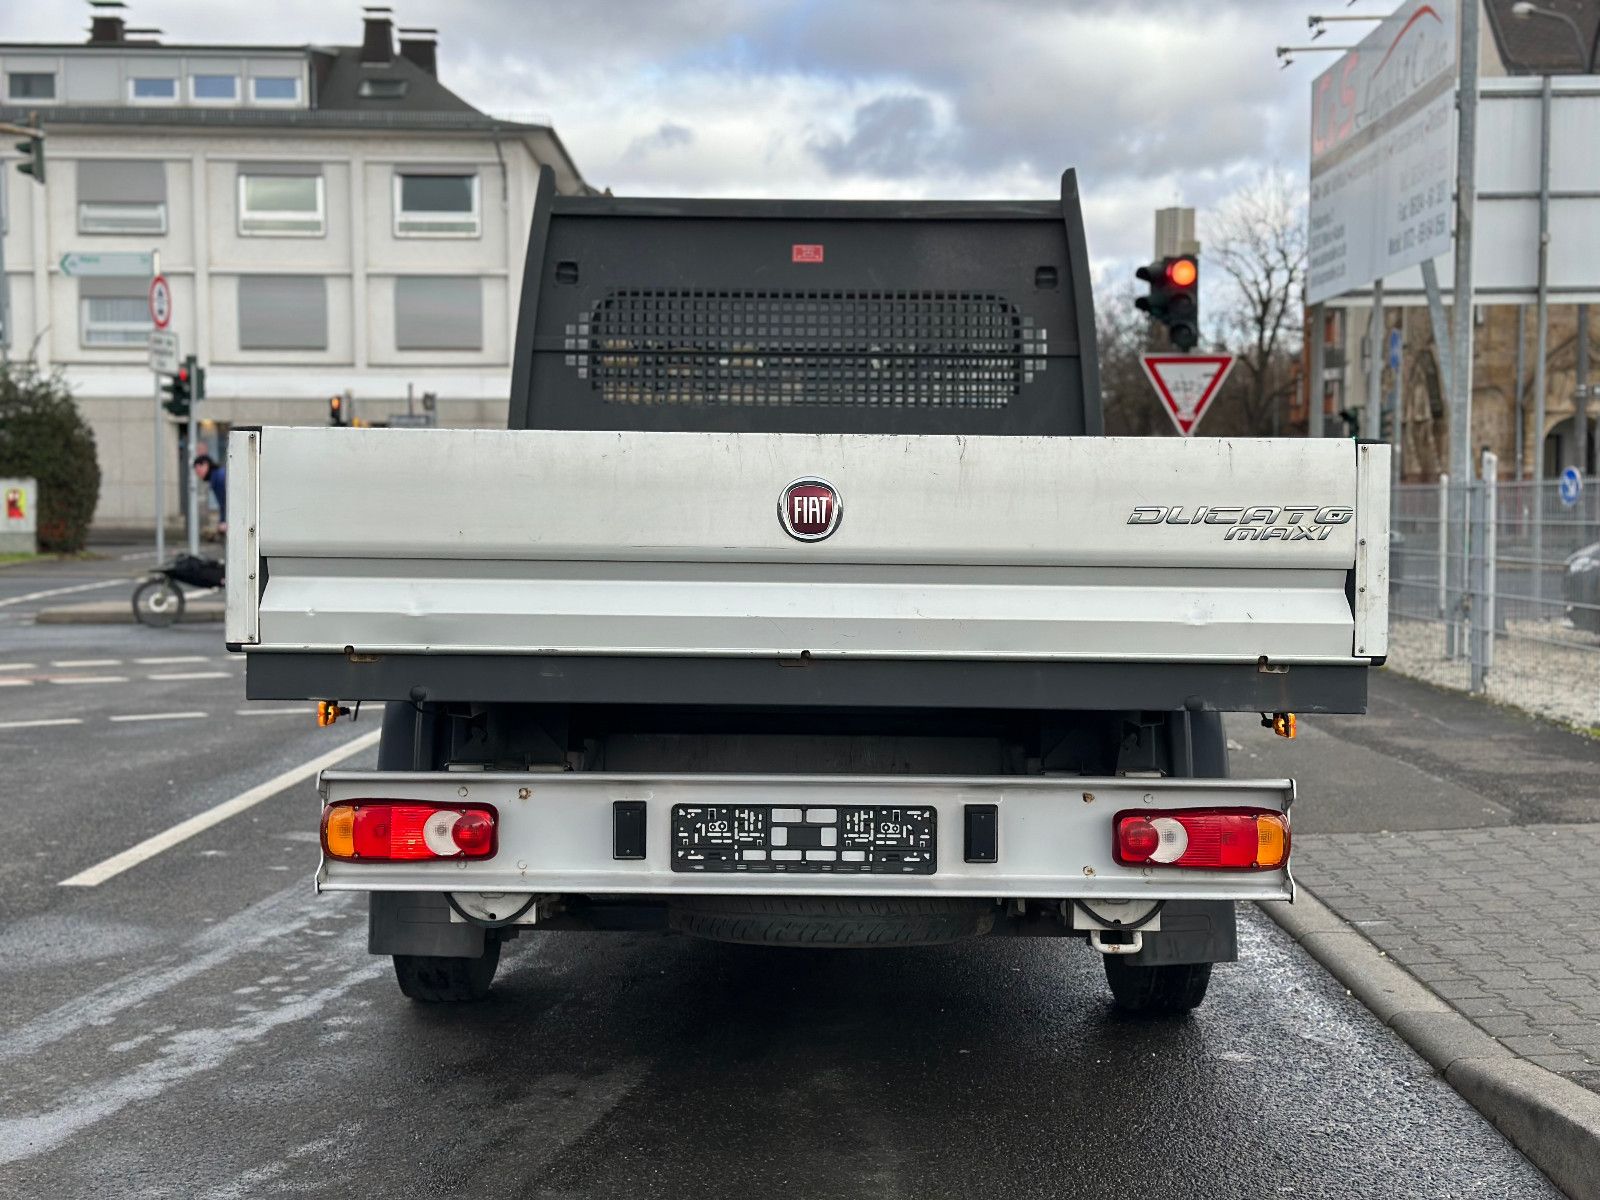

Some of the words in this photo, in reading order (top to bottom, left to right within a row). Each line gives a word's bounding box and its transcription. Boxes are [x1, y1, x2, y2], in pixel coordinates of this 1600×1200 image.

[794, 496, 829, 524] FIAT
[1127, 505, 1353, 524] DUCATO
[1224, 525, 1333, 541] MAXI
